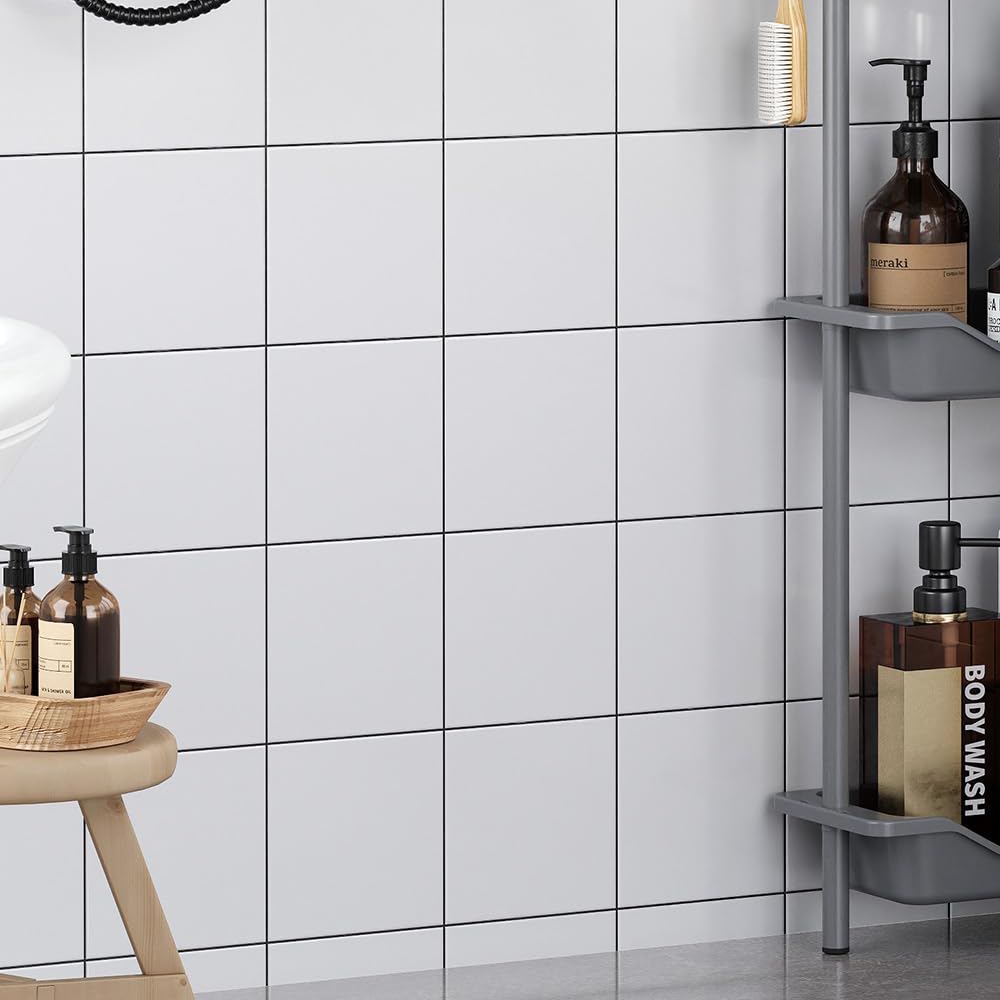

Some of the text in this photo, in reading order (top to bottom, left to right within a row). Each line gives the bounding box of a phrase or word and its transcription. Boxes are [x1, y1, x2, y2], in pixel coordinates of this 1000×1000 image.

[870, 258, 909, 268] meraki
[965, 664, 986, 816] BODY WASH
